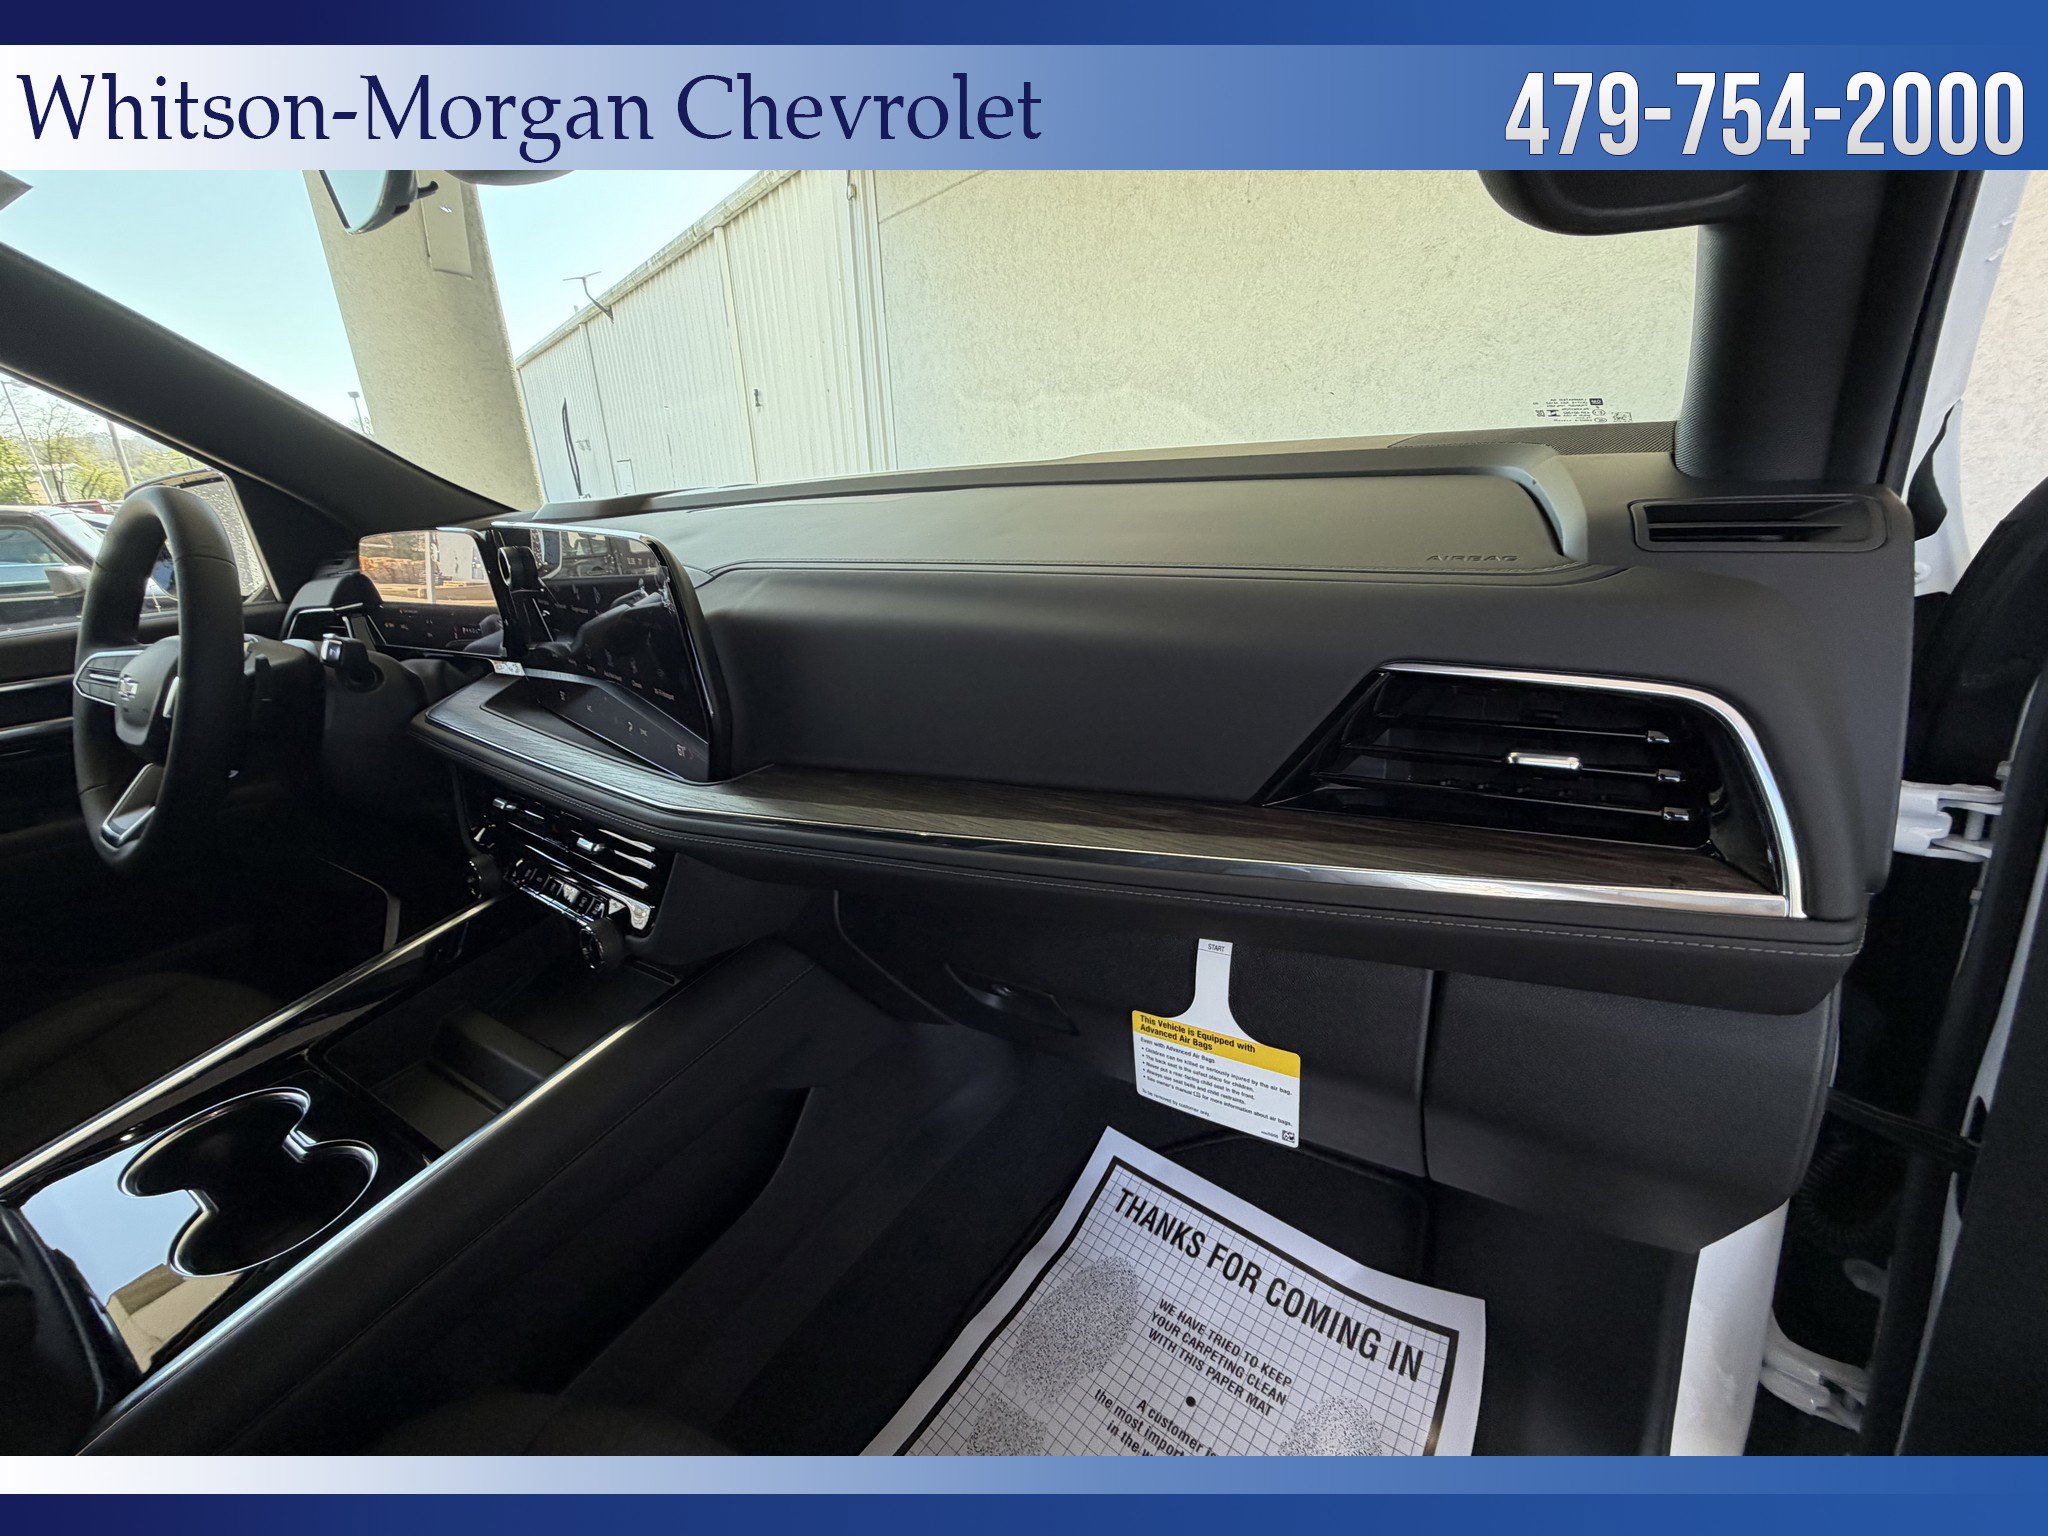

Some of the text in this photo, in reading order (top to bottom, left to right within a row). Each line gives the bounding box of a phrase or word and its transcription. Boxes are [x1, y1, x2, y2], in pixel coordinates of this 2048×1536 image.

[1207, 943, 1225, 953] START
[1140, 1014, 1255, 1053] This Vehicle is Equipped with
[1140, 1023, 1212, 1051] Advanced Air Bags
[1140, 1036, 1152, 1044] Even
[1154, 1040, 1164, 1048] with
[1166, 1044, 1190, 1056] Advanced
[1201, 1054, 1214, 1063] Bags
[1145, 1047, 1164, 1057] Children
[1184, 1059, 1197, 1067] killed
[1206, 1065, 1229, 1077] seriously
[1231, 1073, 1249, 1083] injured
[1279, 1087, 1291, 1096] bag.
[1192, 1068, 1207, 1077] safest
[1209, 1074, 1221, 1082] place
[1231, 1080, 1254, 1091] children.
[1114, 1187, 1424, 1382] THANKS FOR COMING IN
[1151, 1311, 1287, 1406] YOUR CARPETING CLEAN
[1159, 1298, 1292, 1387] WE HAVE TRIED TO KEEP
[1148, 1328, 1273, 1416] WITH THIS PAPER MAT
[1094, 1388, 1113, 1408] the
[1114, 1405, 1144, 1433] most
[1137, 1400, 1147, 1412] A
[1147, 1408, 1203, 1453] customer
[1106, 1420, 1140, 1453] in the
